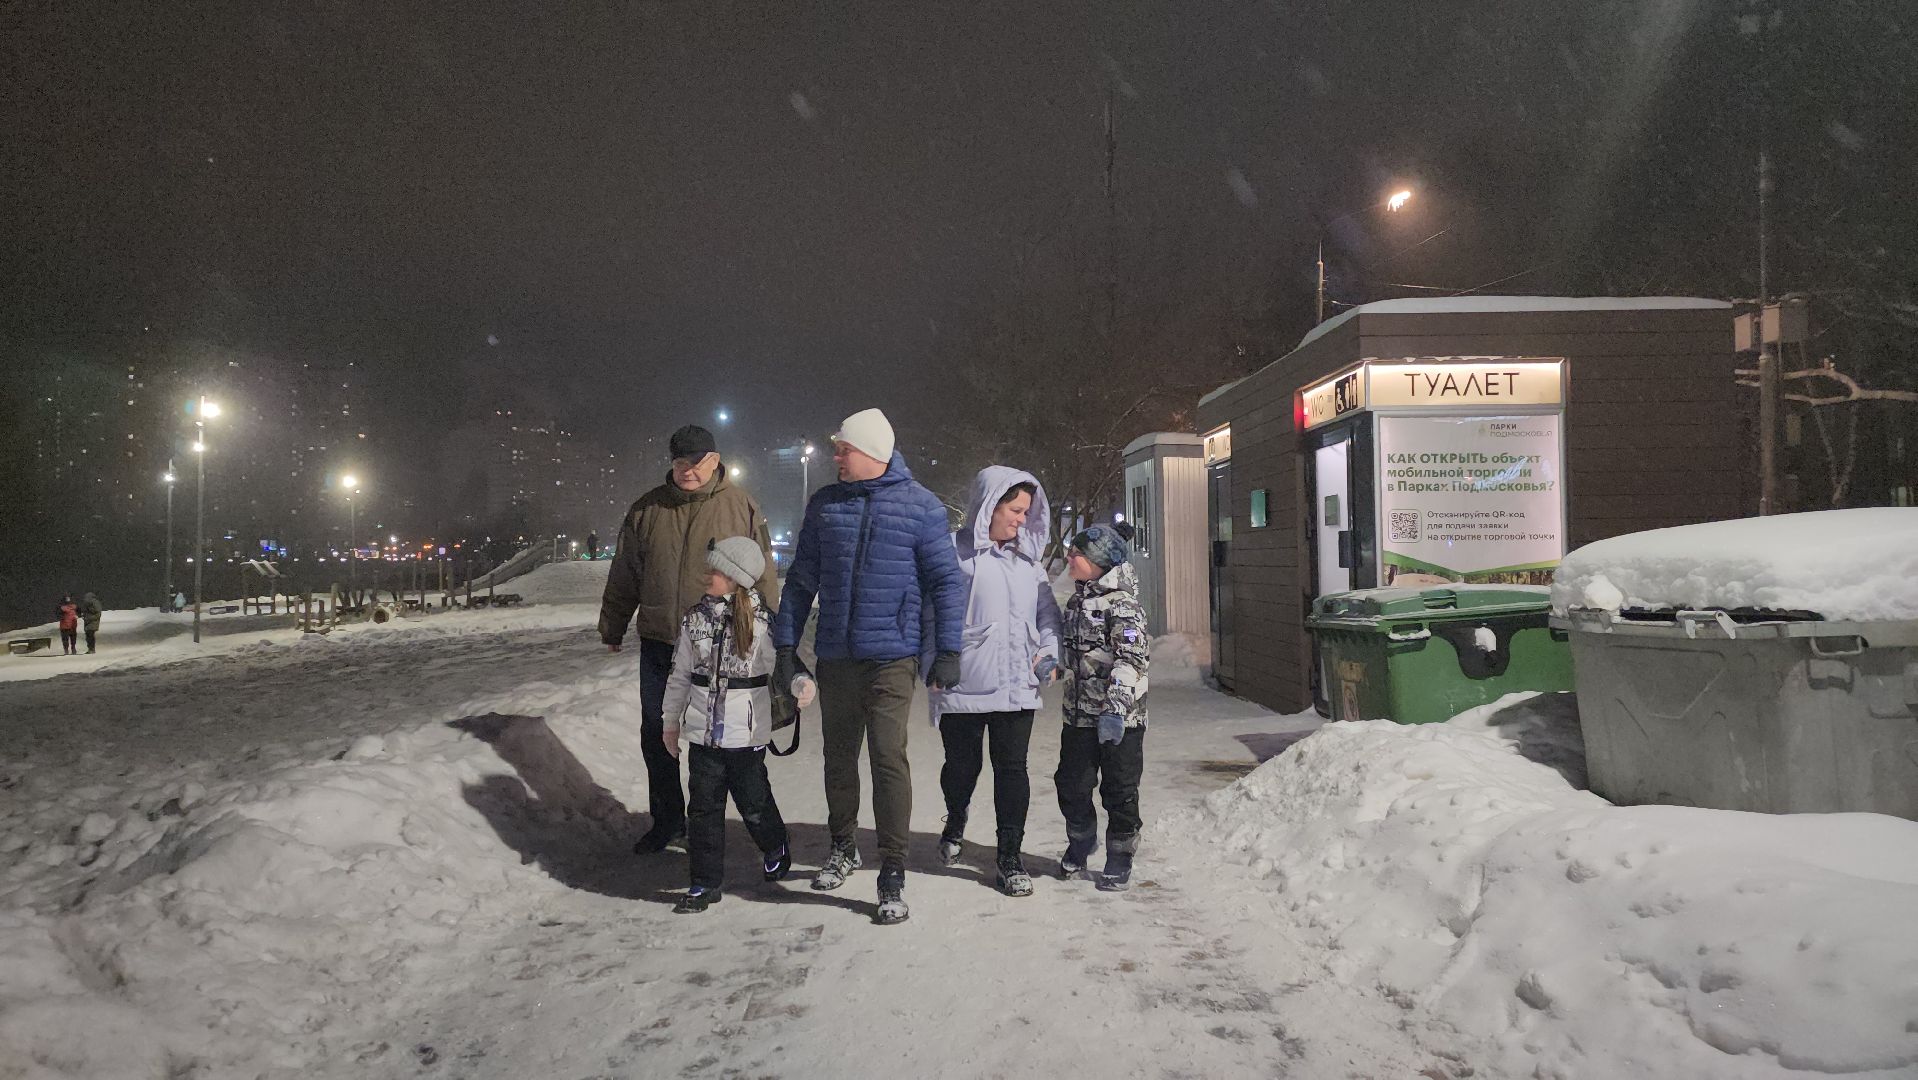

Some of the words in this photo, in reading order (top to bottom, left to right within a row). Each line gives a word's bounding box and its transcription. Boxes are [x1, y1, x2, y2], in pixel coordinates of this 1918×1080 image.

[1404, 372, 1520, 396] ТУАЛЕТ
[1387, 453, 1416, 464] КАК
[1420, 453, 1488, 464] ОТКРЫТЬ
[1387, 466, 1464, 478] мобильной
[1467, 467, 1532, 480] торгои
[1387, 483, 1394, 492] в
[1397, 481, 1449, 494] Парках
[1427, 510, 1490, 519] Отсканируйте
[1492, 510, 1525, 520] QR-код
[1427, 522, 1442, 530] для
[1445, 522, 1476, 530] подачи
[1478, 522, 1509, 530] заявки
[1440, 533, 1481, 542] открытие
[1484, 532, 1526, 542] торговой
[1528, 532, 1555, 541] точки
